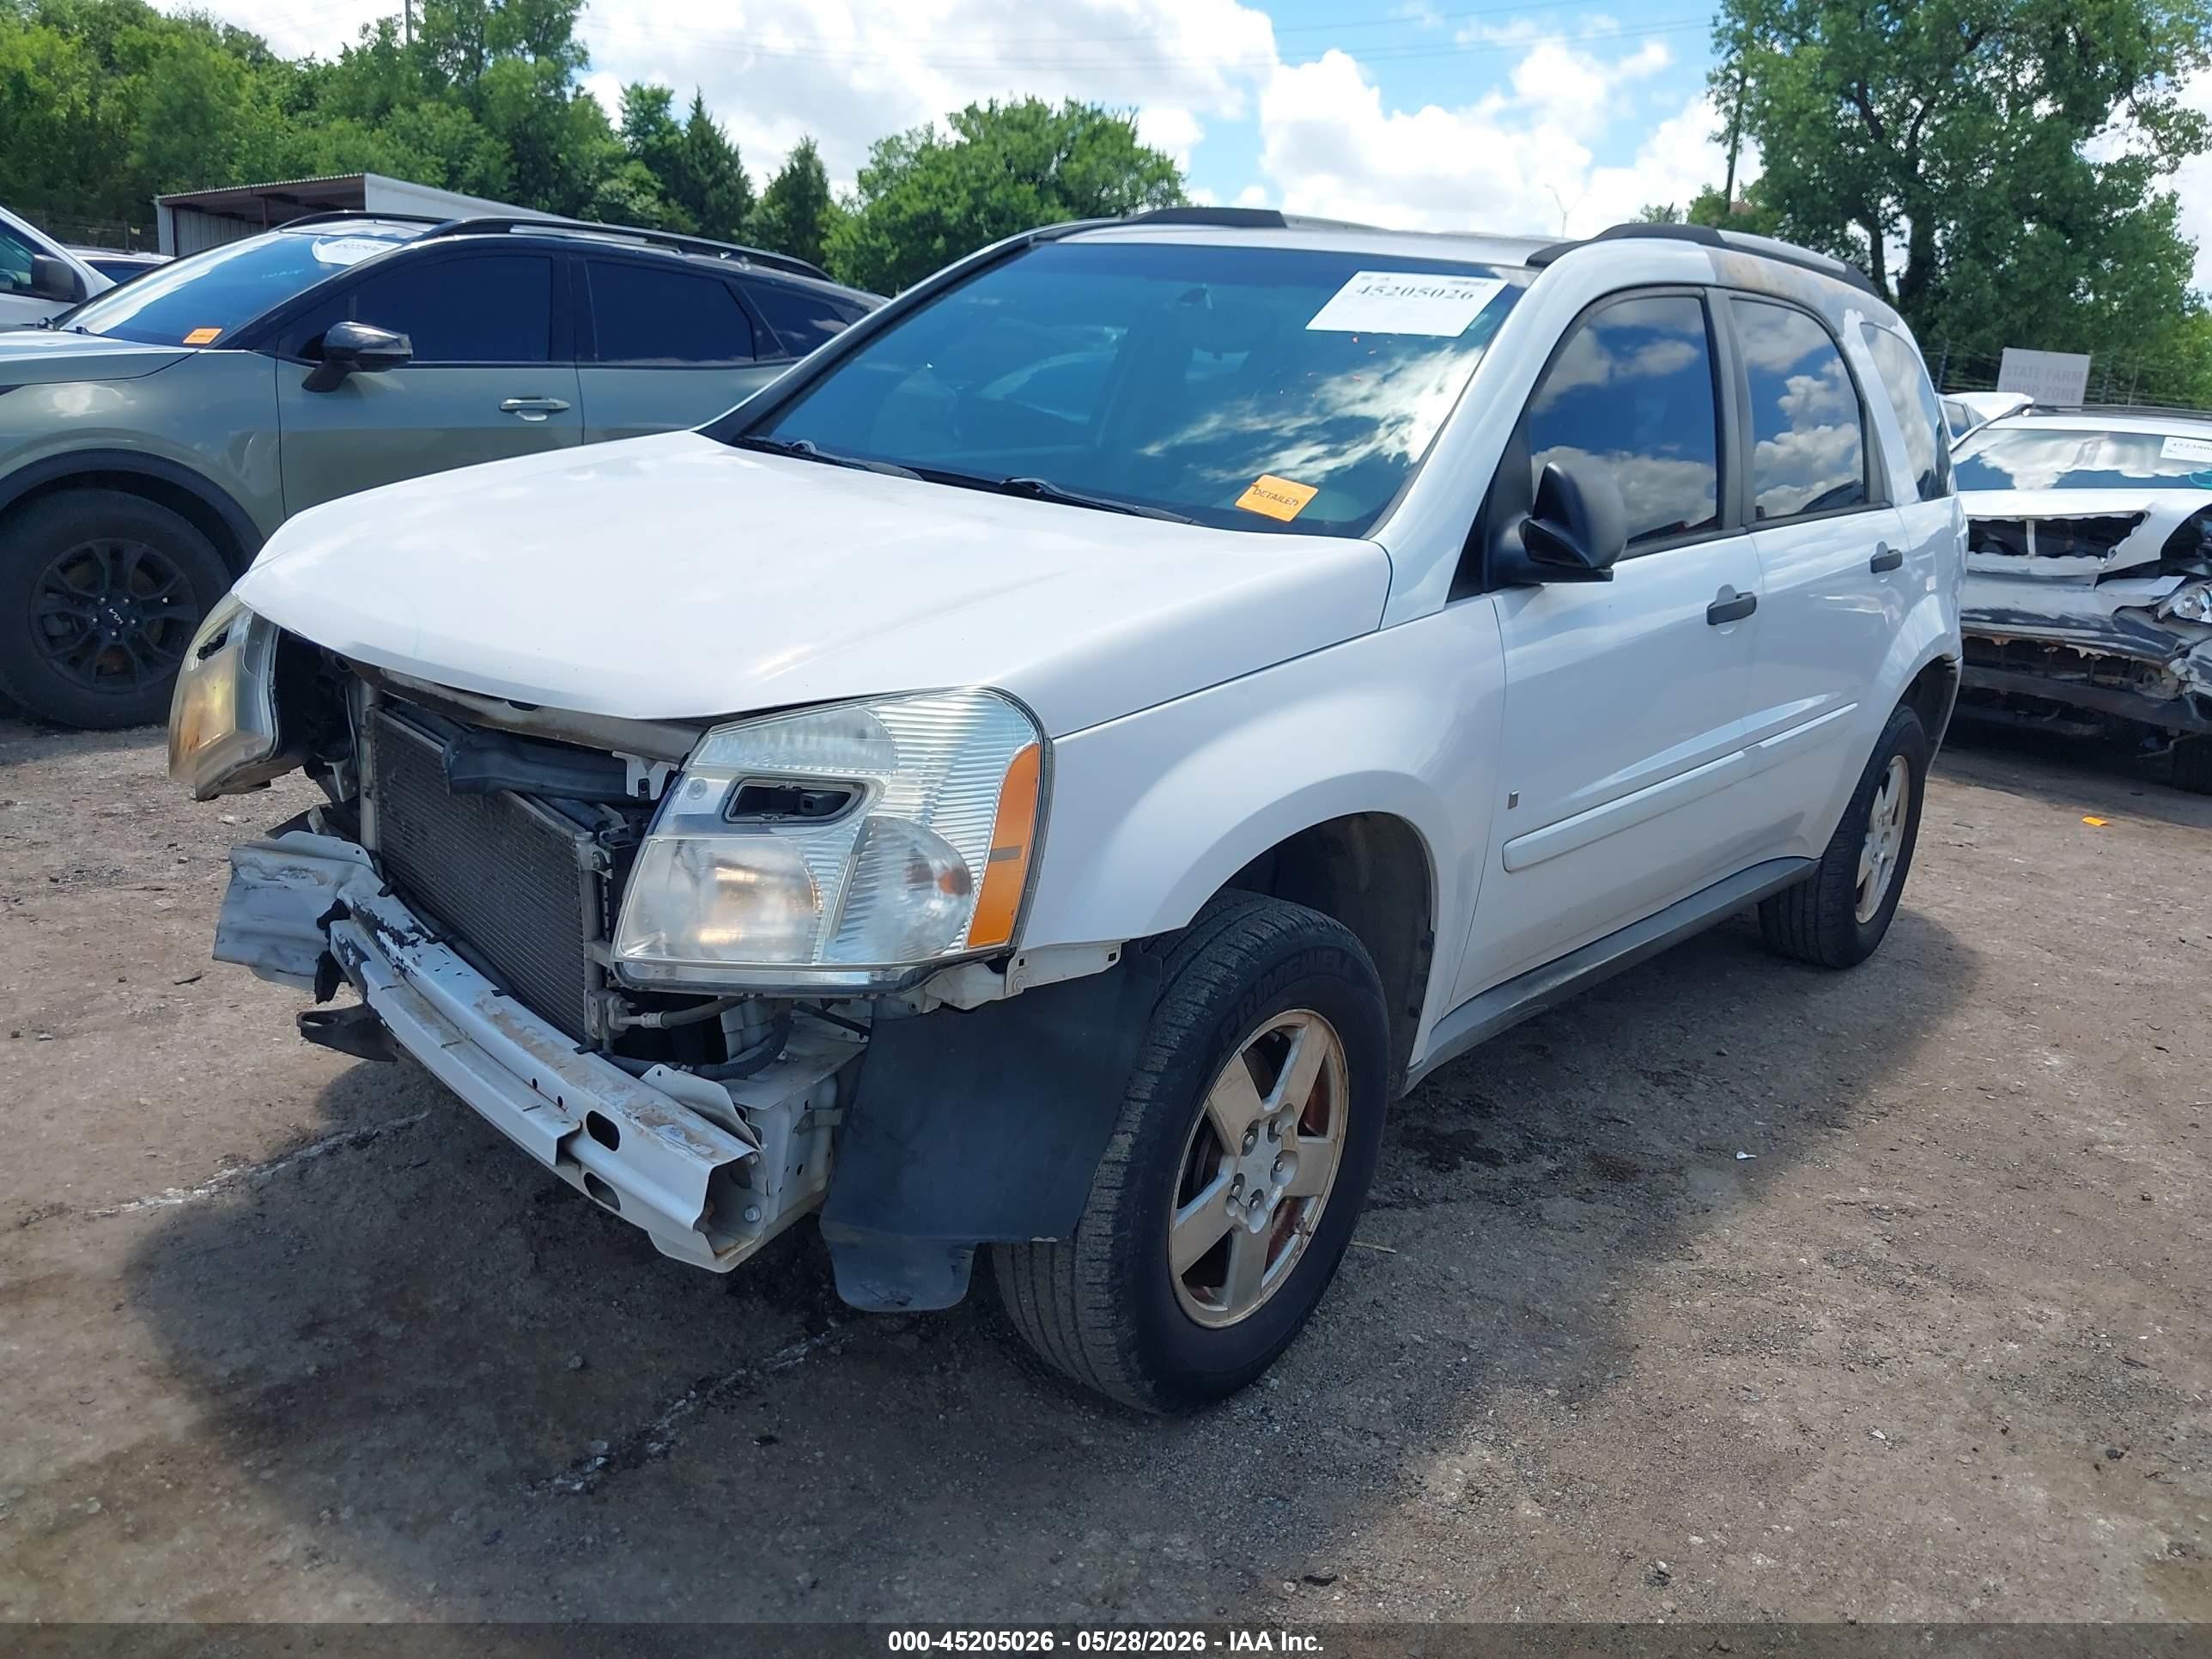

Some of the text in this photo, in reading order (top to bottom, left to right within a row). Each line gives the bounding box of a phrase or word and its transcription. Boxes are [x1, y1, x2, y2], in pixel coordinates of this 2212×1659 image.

[1356, 284, 1474, 300] 45205026
[2003, 364, 2084, 384] STATE FARM
[2043, 386, 2078, 401] ZONE
[1253, 489, 1299, 507] DETAILED
